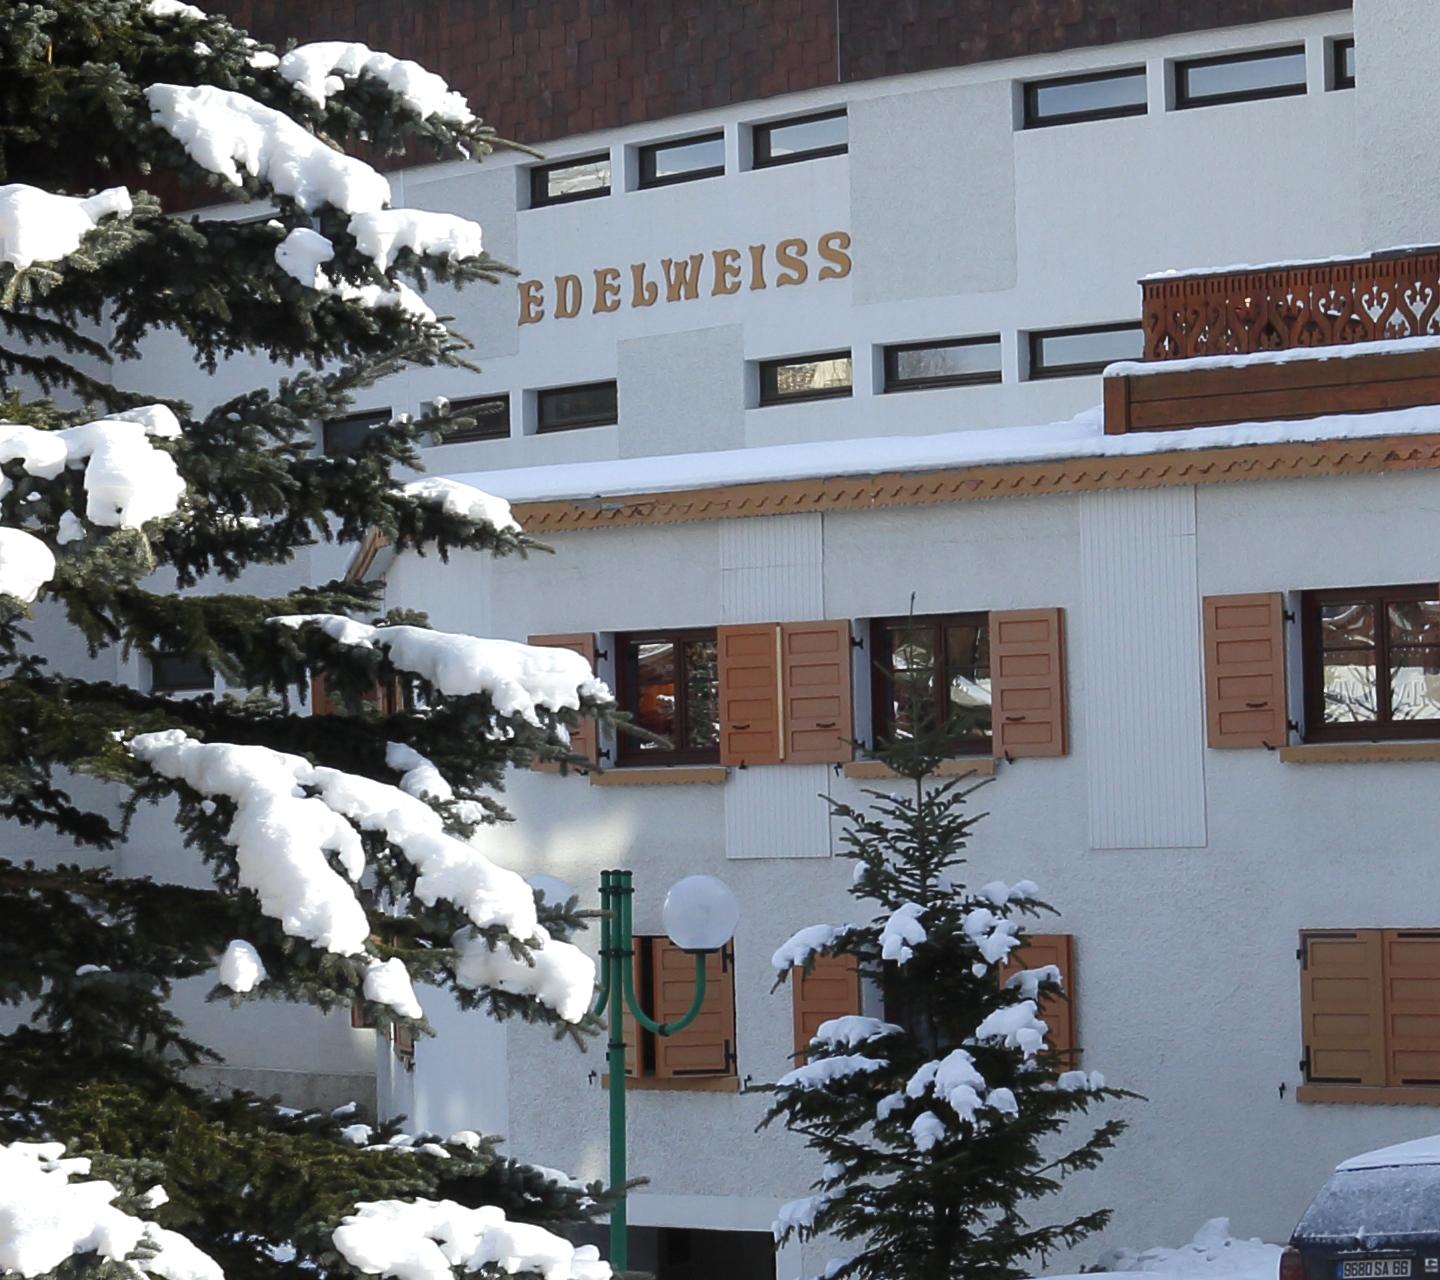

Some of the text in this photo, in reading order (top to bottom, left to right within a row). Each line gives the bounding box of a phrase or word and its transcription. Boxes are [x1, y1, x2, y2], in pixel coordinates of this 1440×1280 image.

[517, 231, 853, 327] EDELWEISS
[1344, 1261, 1408, 1277] 9680 SA 66
